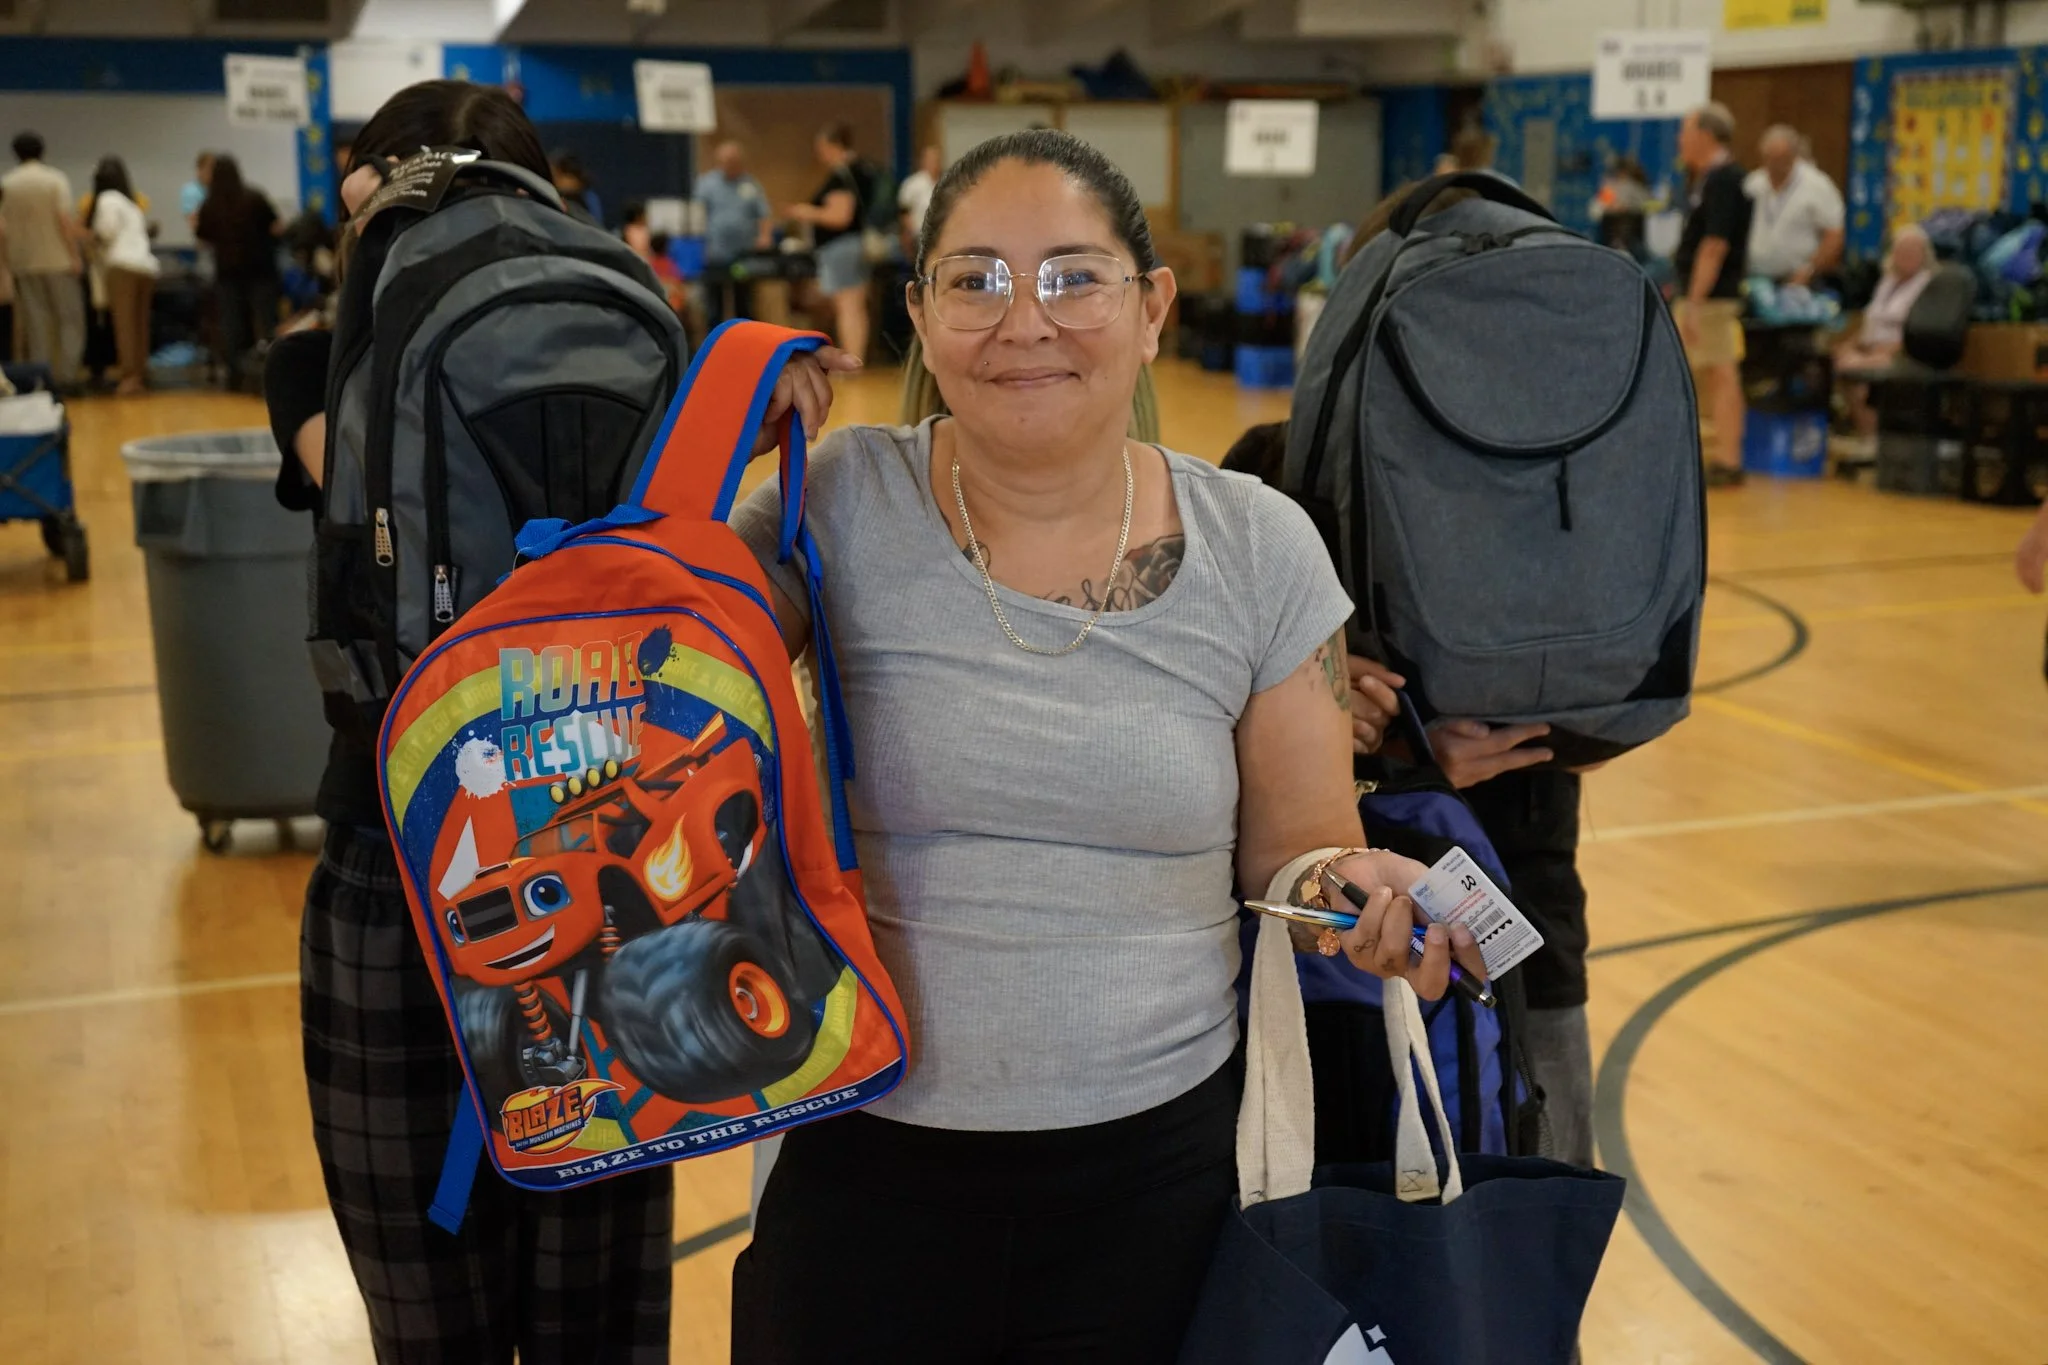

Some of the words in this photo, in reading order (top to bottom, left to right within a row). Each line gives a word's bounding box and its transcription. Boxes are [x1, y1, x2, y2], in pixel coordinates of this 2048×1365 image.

[499, 631, 645, 721] ROAD
[506, 1087, 582, 1142] BLAZE
[529, 1130, 554, 1145] MONSTER
[554, 1118, 582, 1138] MACHINES
[555, 1148, 645, 1179] BLAZE
[648, 1139, 686, 1154] TO
[689, 1122, 748, 1145] THE
[752, 1088, 859, 1128] RESCUE
